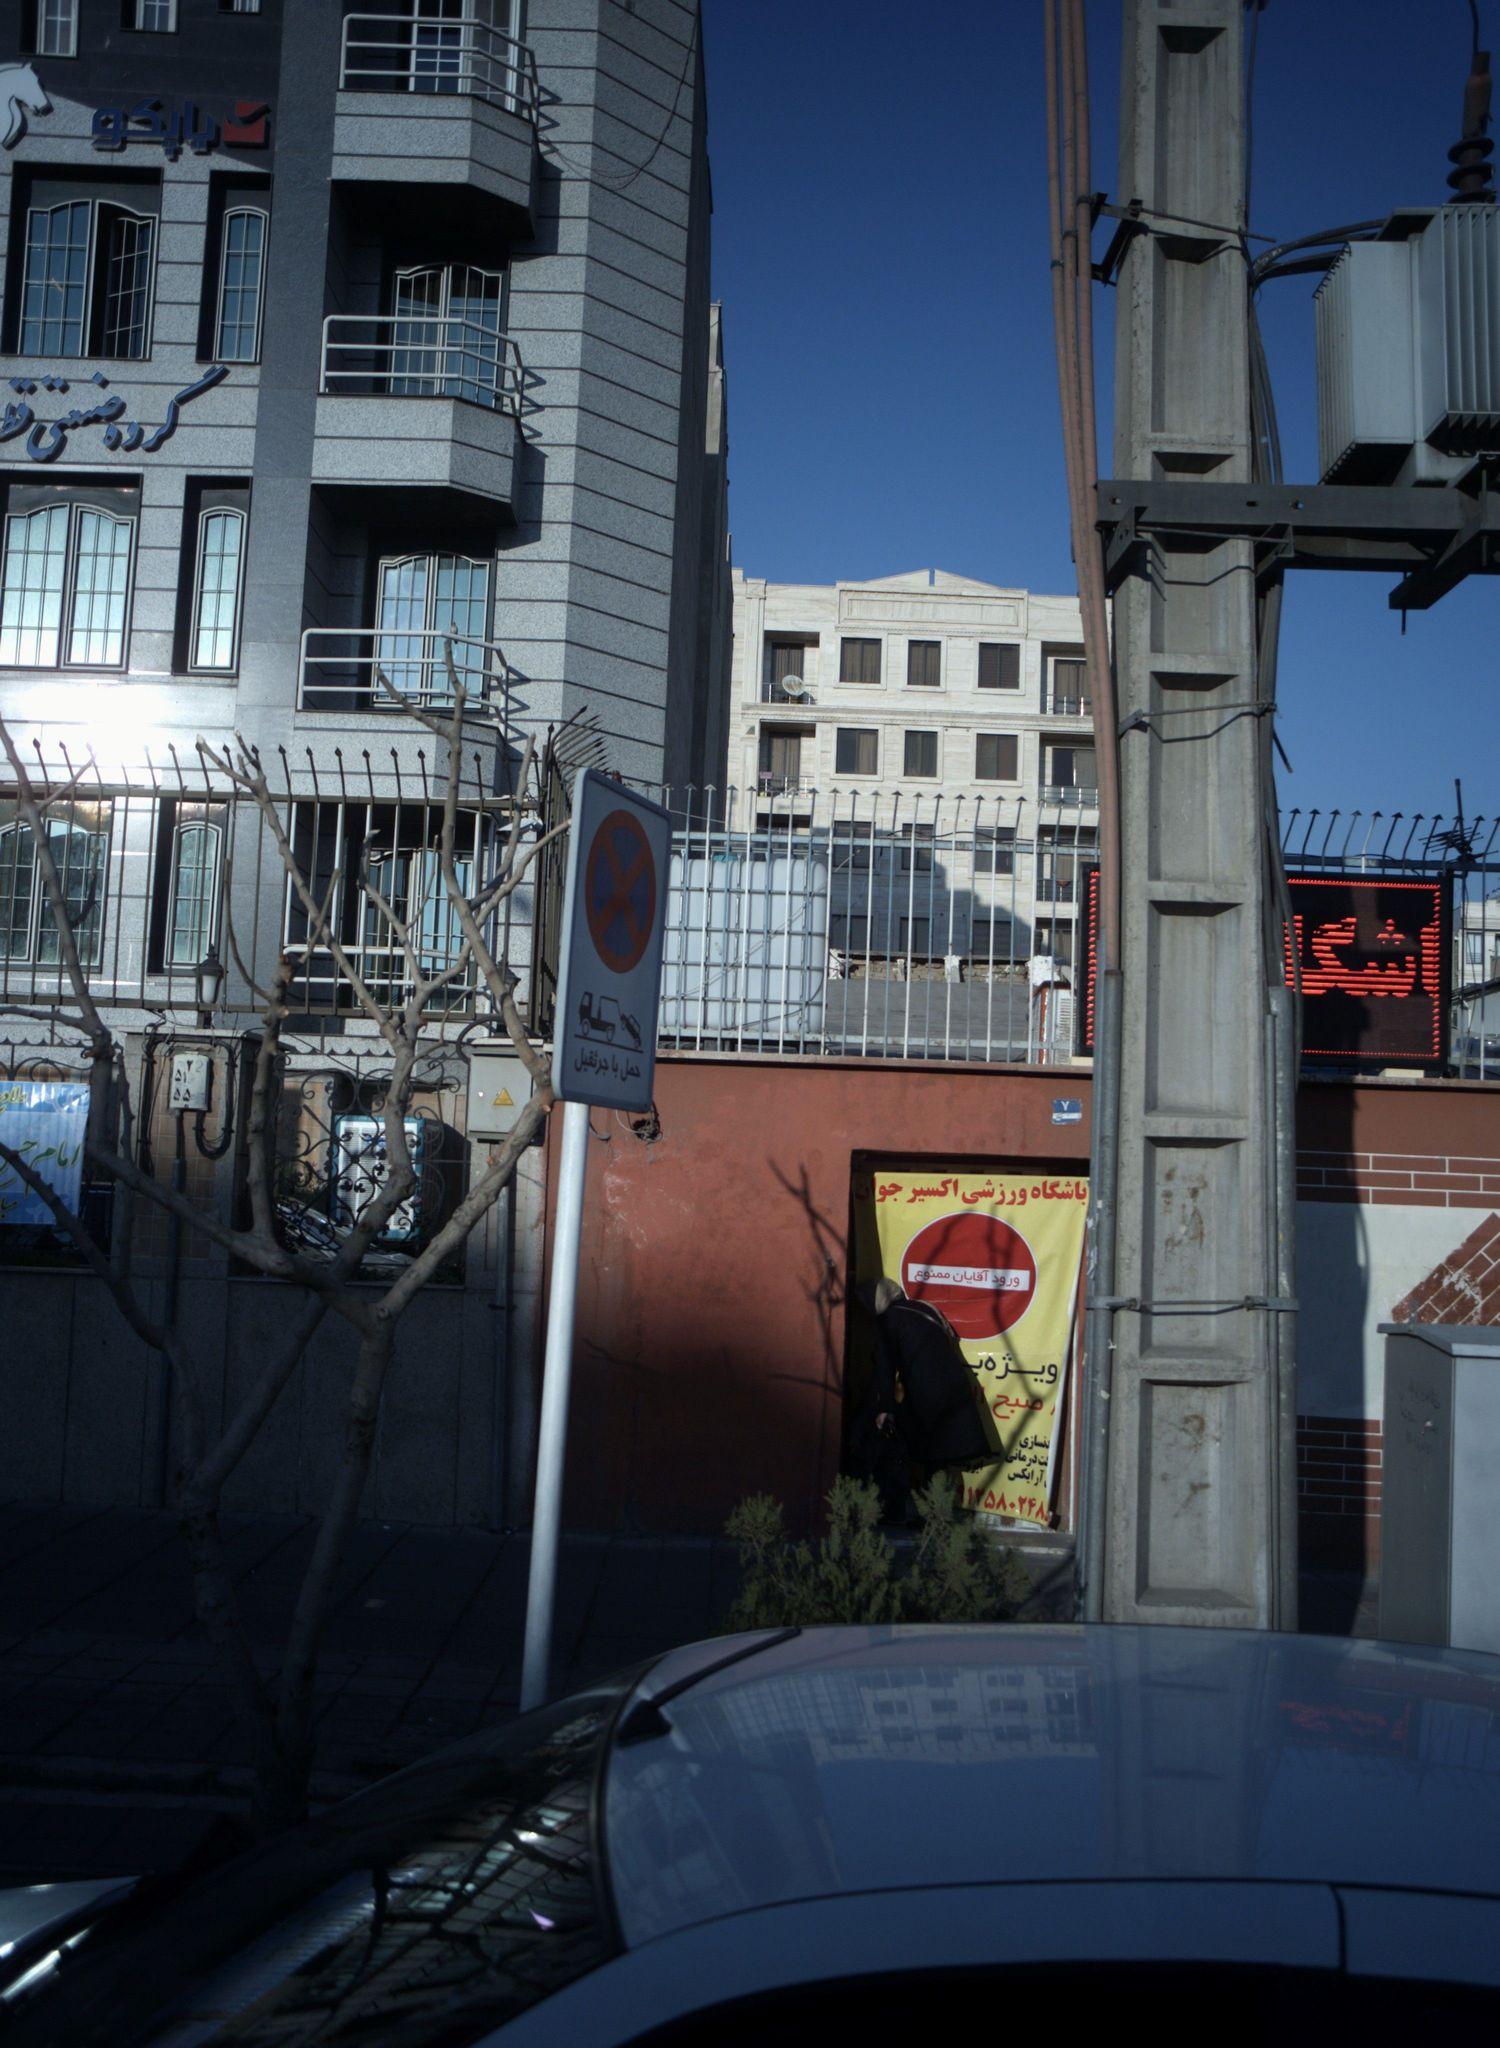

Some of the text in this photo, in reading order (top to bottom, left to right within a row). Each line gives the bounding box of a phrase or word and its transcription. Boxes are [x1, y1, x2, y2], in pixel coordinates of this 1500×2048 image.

[26, 370, 126, 463] صنعتی
[103, 364, 230, 452] گروه
[574, 1048, 641, 1082] حمل با جرثقیل
[906, 1178, 959, 1203] اکسیر
[961, 1179, 1027, 1206] ورزشی
[1030, 1179, 1088, 1206] باشگاه
[914, 1269, 1021, 1288] ورود آقایان ممنوع
[992, 1394, 1043, 1419] صبح
